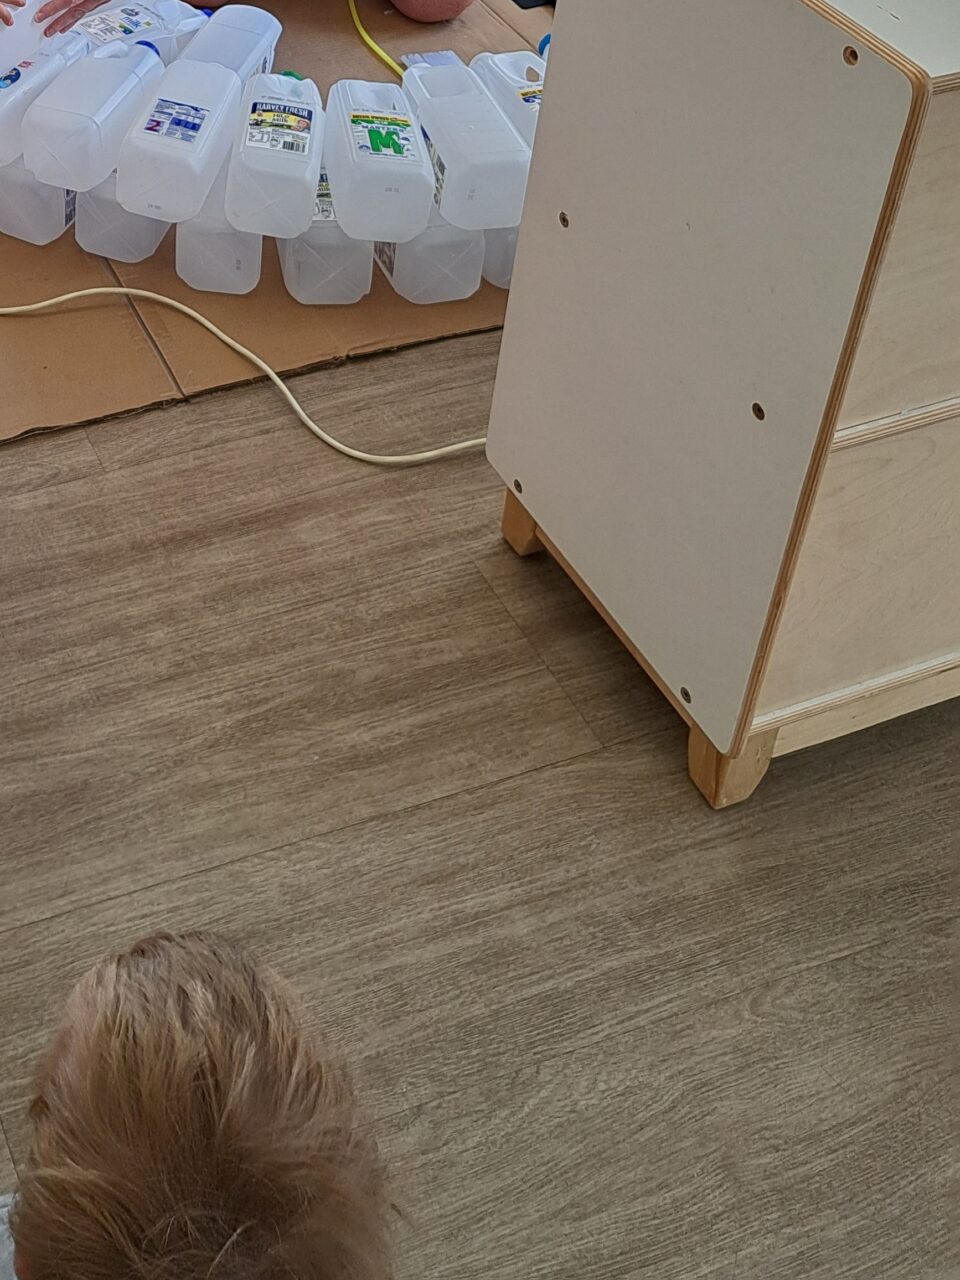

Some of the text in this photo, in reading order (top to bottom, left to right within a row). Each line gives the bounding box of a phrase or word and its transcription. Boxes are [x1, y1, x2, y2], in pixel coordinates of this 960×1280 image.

[256, 103, 309, 117] HARVEY FRESH
[144, 118, 161, 132] 2
